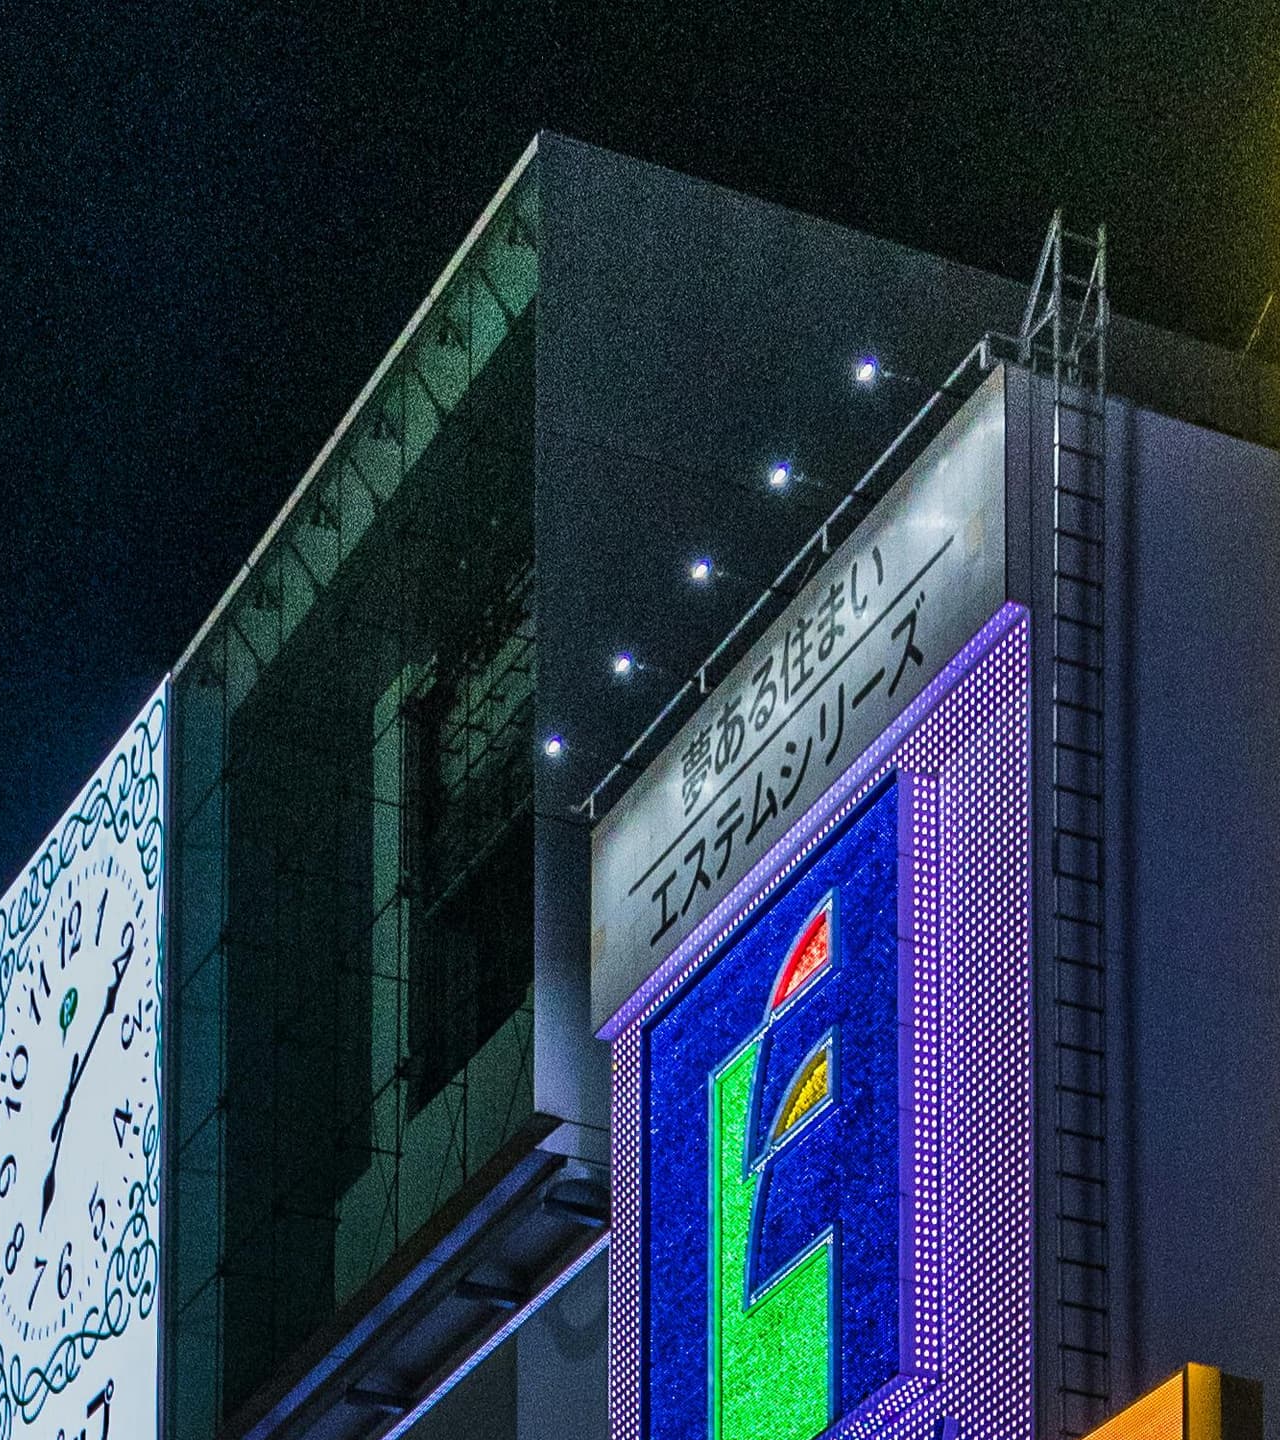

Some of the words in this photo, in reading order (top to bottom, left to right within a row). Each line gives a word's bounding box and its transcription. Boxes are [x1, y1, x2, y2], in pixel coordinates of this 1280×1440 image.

[681, 546, 884, 816] 夢ある住まい
[650, 592, 926, 946] エステムシリーズ
[57, 899, 82, 970] 12
[95, 887, 109, 948] 1
[29, 960, 51, 1025] 11
[121, 999, 143, 1050] 3
[5, 1044, 29, 1120] 10
[112, 1099, 133, 1148] 4
[89, 1182, 106, 1242] 5
[5, 1222, 25, 1276] 8
[57, 1241, 73, 1300] 6
[29, 1256, 47, 1310] 7
